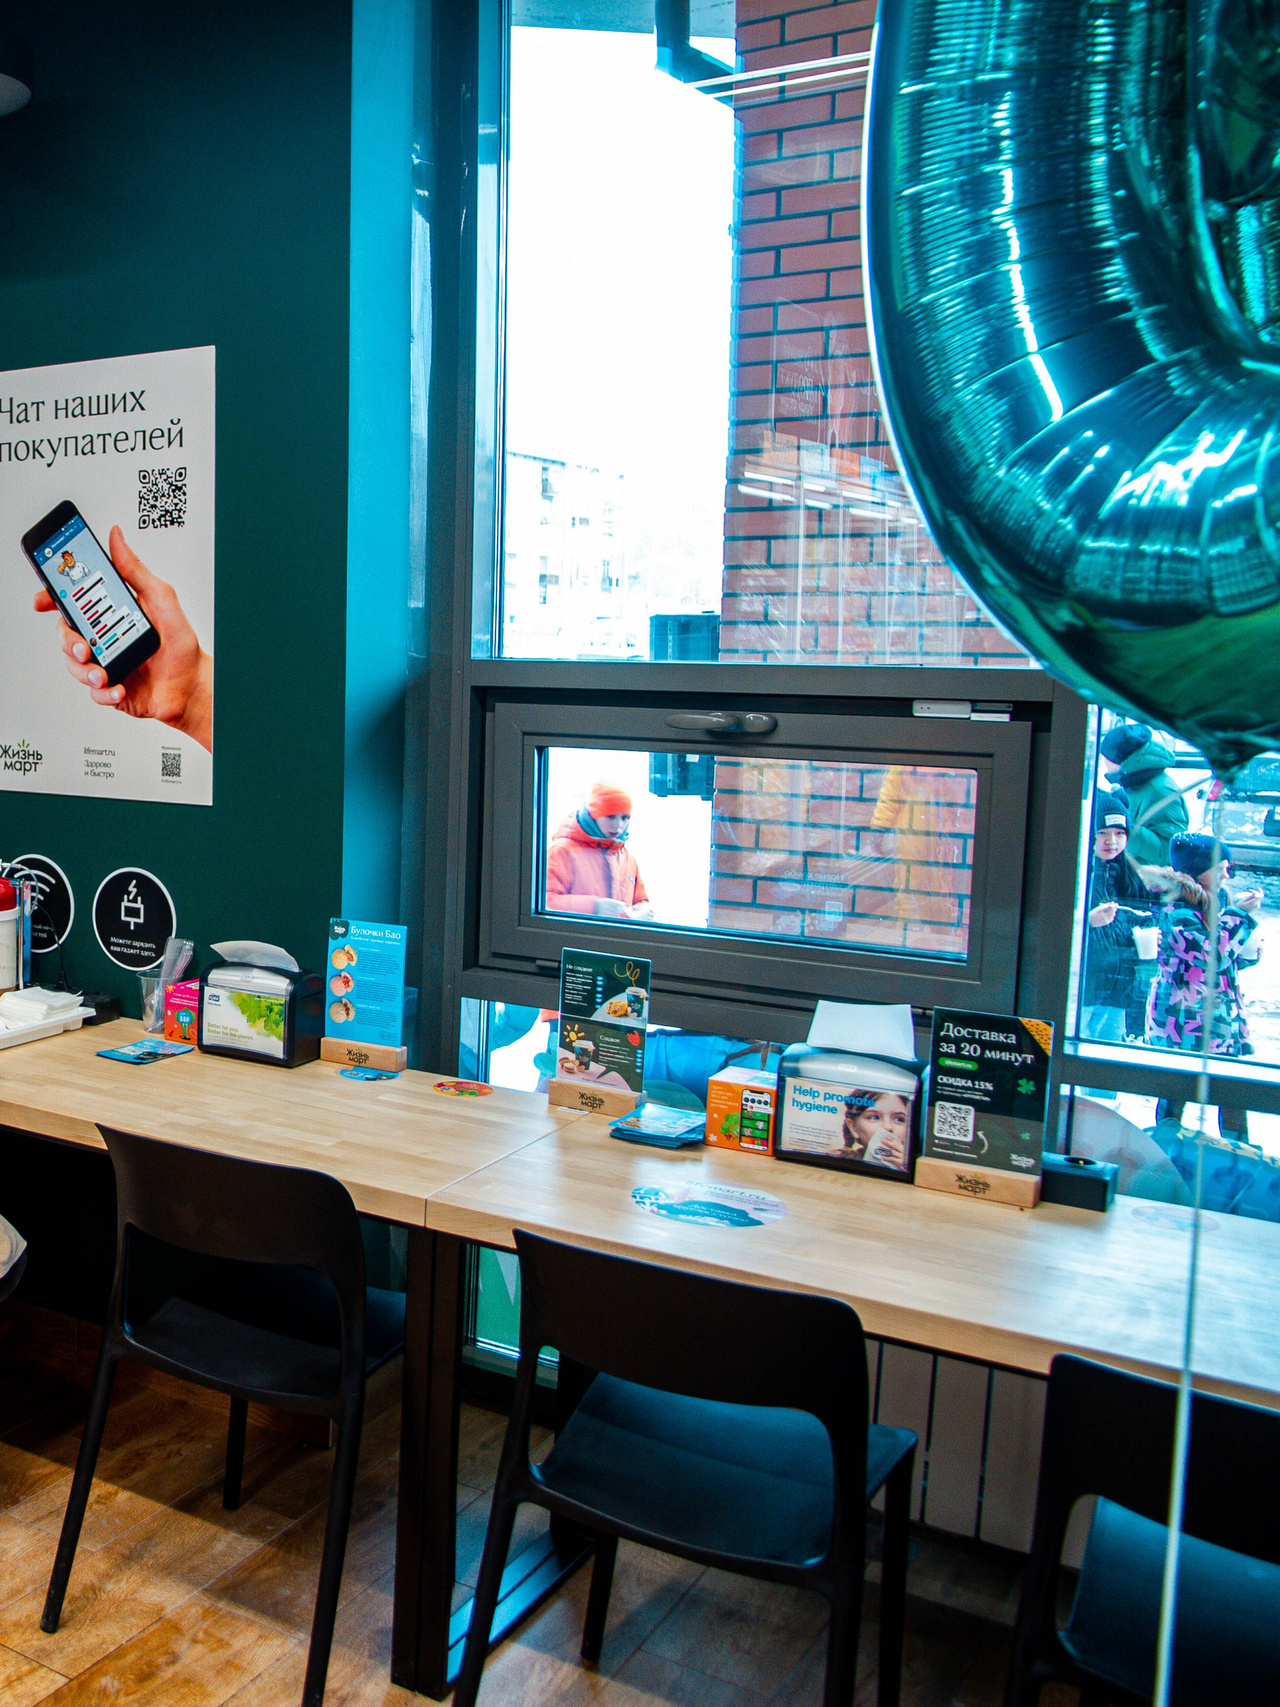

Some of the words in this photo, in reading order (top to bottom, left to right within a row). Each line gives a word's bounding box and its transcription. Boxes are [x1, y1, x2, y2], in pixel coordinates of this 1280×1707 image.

[54, 390, 146, 420] наших
[0, 744, 43, 760] Жизнь
[3, 760, 40, 776] март
[84, 759, 112, 769] Здорово
[89, 769, 115, 779] быстро
[350, 925, 384, 938] Булочки
[385, 929, 402, 940] Бао
[940, 1022, 1017, 1045] Доставка
[939, 1042, 957, 1054] за
[960, 1042, 982, 1057] 20
[983, 1049, 1035, 1067] минут
[937, 1075, 973, 1088] СКИДКА
[974, 1081, 994, 1091] 15%
[793, 1085, 821, 1100] Help
[823, 1092, 876, 1108] promote
[791, 1098, 838, 1115] hygiene
